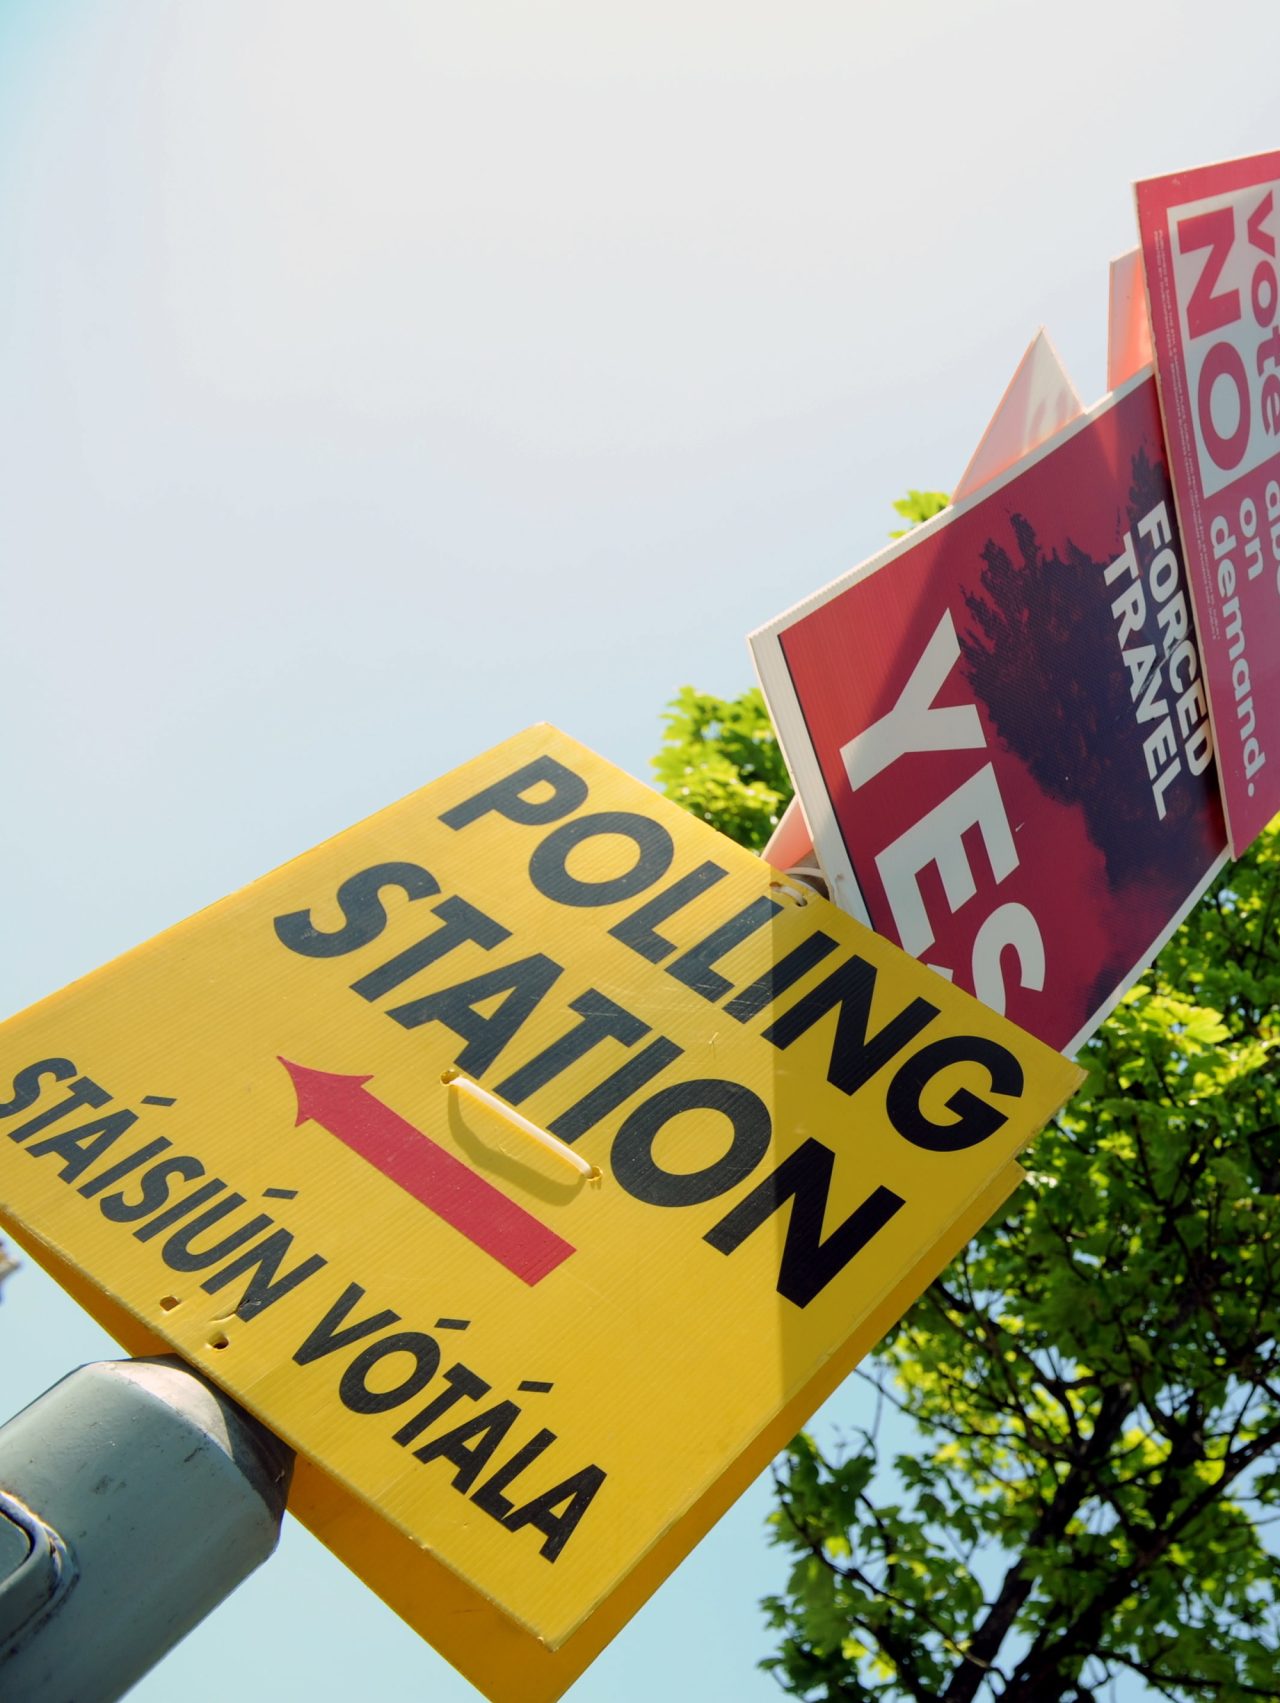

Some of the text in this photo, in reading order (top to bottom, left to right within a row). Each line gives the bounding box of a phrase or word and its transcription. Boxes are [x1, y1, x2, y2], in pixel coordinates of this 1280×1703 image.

[1176, 206, 1251, 471] NO
[1103, 532, 1181, 821] TRAVEL
[1137, 500, 1214, 777] FORCED
[1210, 515, 1266, 798] demand.
[1239, 498, 1264, 580] on
[437, 755, 1024, 1153] POLLING
[839, 607, 1046, 1017] YES
[273, 861, 906, 1310] STATION
[0, 1057, 607, 1564] STÁISIÚN VÓTÁLA
